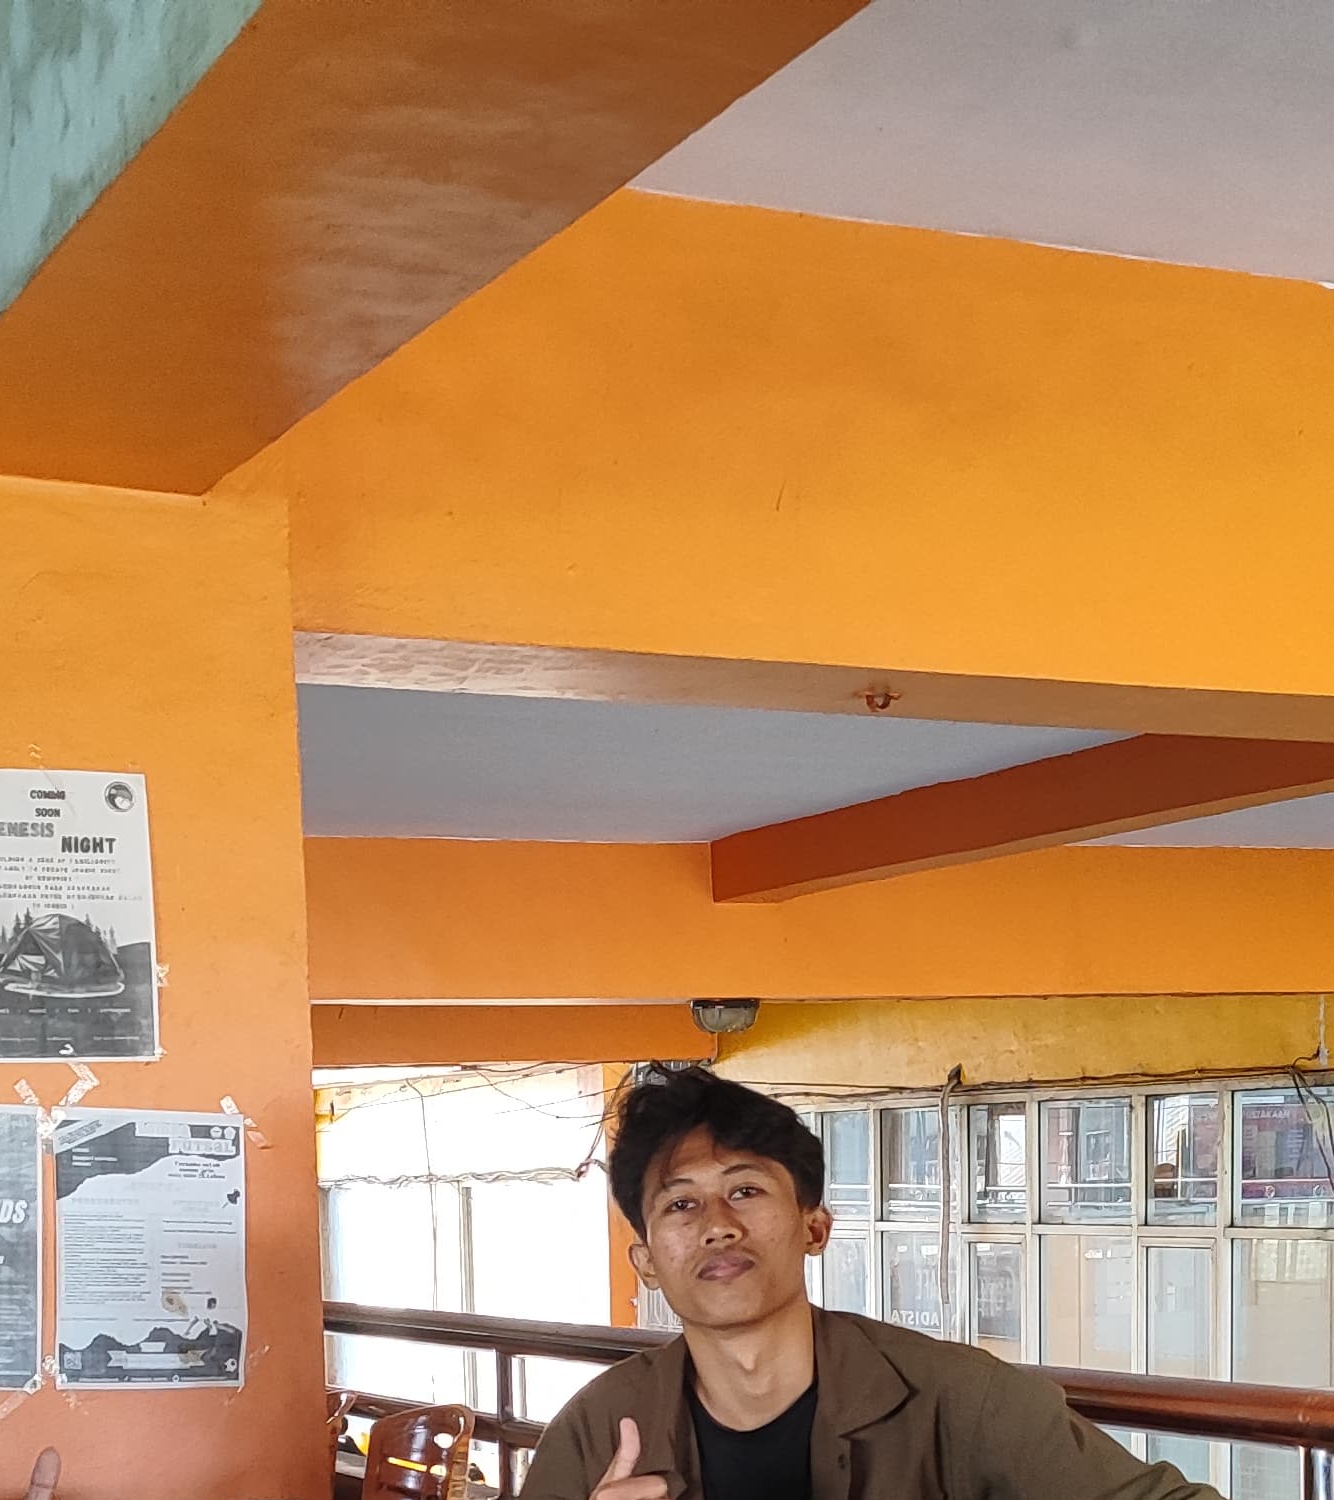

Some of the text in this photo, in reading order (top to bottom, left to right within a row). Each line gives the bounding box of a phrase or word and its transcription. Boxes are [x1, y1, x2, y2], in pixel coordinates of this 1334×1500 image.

[30, 789, 65, 800] COMING
[35, 808, 61, 817] SOON
[61, 836, 117, 853] NIGHT
